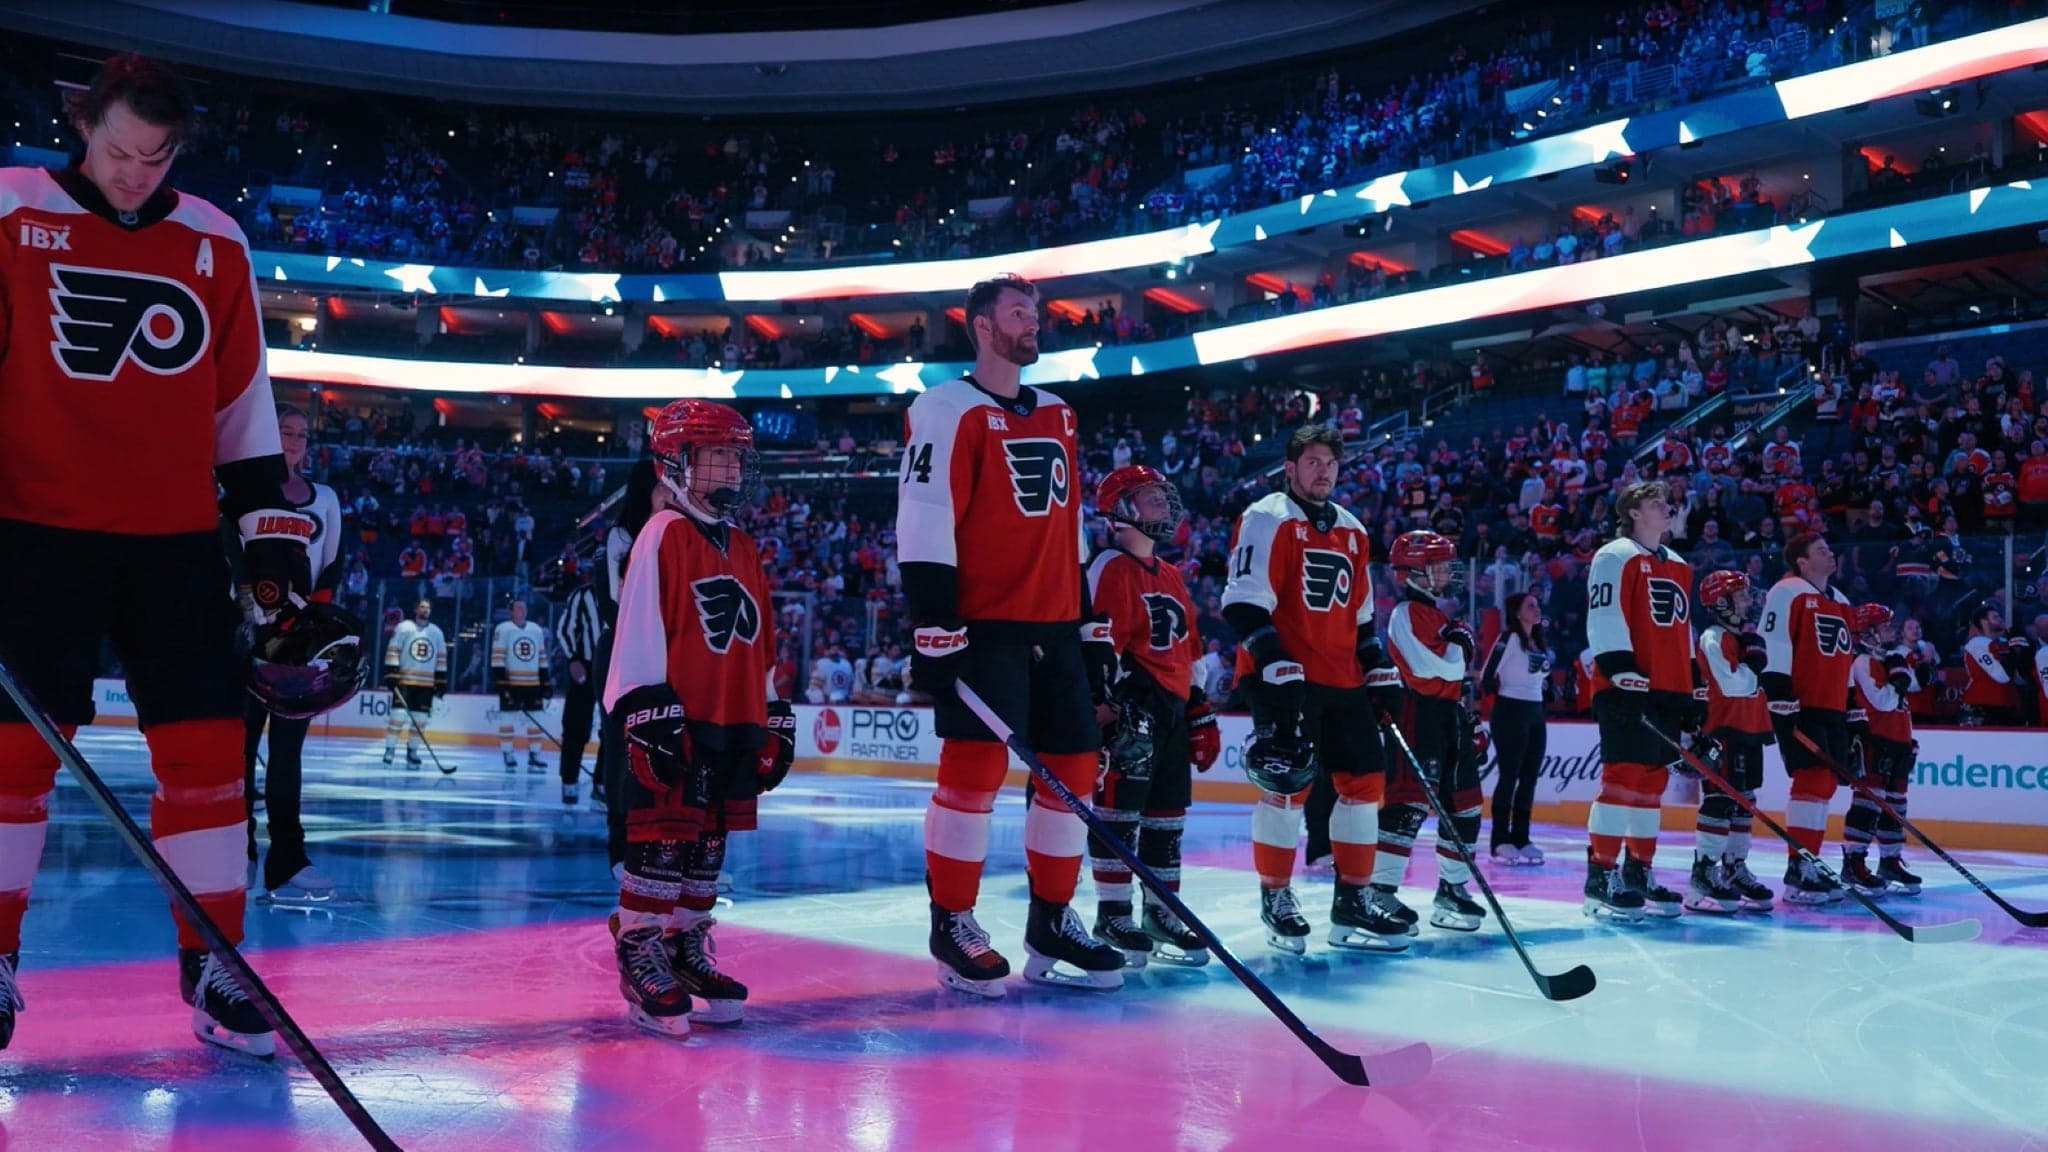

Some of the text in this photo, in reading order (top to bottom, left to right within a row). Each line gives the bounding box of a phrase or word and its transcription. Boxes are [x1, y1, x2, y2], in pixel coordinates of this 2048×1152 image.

[20, 225, 72, 251] IBX
[195, 238, 214, 278] A
[1062, 408, 1075, 437] C
[1591, 583, 1613, 609] 20
[917, 634, 966, 649] CCM
[359, 694, 391, 716] Hol
[851, 710, 919, 741] PRO
[850, 743, 919, 760] PARTNER
[1909, 754, 2048, 789] ndence
